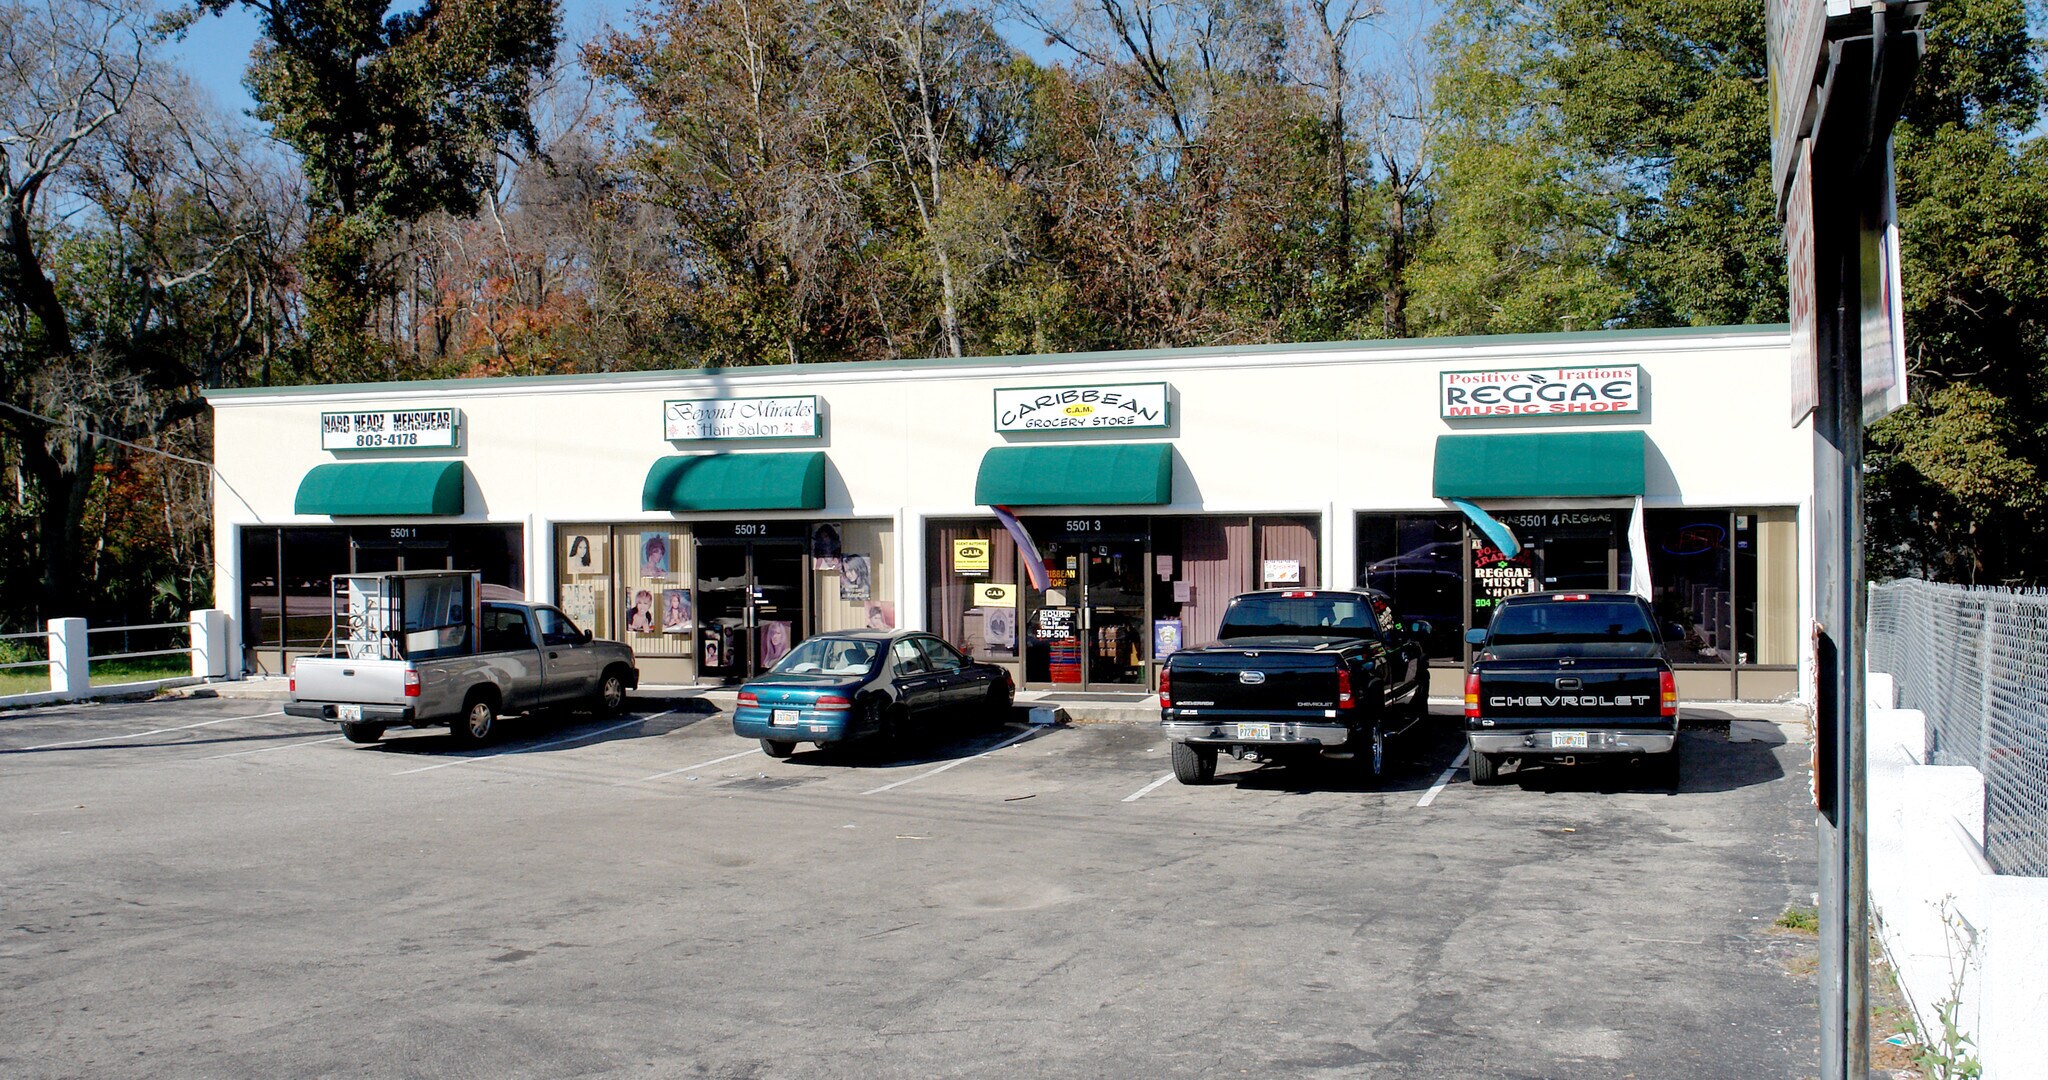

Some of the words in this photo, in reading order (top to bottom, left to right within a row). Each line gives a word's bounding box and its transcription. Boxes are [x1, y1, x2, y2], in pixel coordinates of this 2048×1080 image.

[1450, 371, 1520, 385] Positive
[1558, 368, 1632, 381] Irations
[1447, 380, 1632, 405] REGGAE
[667, 402, 737, 426] Beyond
[740, 400, 814, 418] Miracles
[1001, 389, 1159, 426] CARIBBEAN
[1065, 405, 1094, 414] C.A.M.
[1450, 404, 1541, 416] MUSIC
[1549, 401, 1629, 413] SHOP
[324, 415, 350, 433] HARD
[354, 414, 385, 432] HEADZ
[393, 411, 450, 432] MENSWEAR
[1025, 417, 1086, 428] GROCERY
[1093, 416, 1136, 426] STORE
[701, 423, 734, 437] Hair
[737, 422, 779, 436] Salon
[356, 433, 418, 447] 803-4178
[1519, 514, 1547, 527] 5501
[1551, 514, 1560, 527] 4
[1561, 513, 1612, 524] REGGAE
[735, 524, 757, 535] 5501
[760, 524, 766, 534] 2
[1066, 520, 1090, 531] 5501
[1094, 520, 1101, 531] 3
[390, 528, 409, 538] 5501
[411, 528, 416, 537] 1
[1046, 569, 1076, 579] RIBBEAN
[1475, 567, 1532, 578] REGGAE
[1049, 578, 1067, 587] TORE
[1483, 577, 1525, 588] MUSIC
[1475, 598, 1491, 607] 904
[1489, 695, 1650, 707] CHEVROLET
